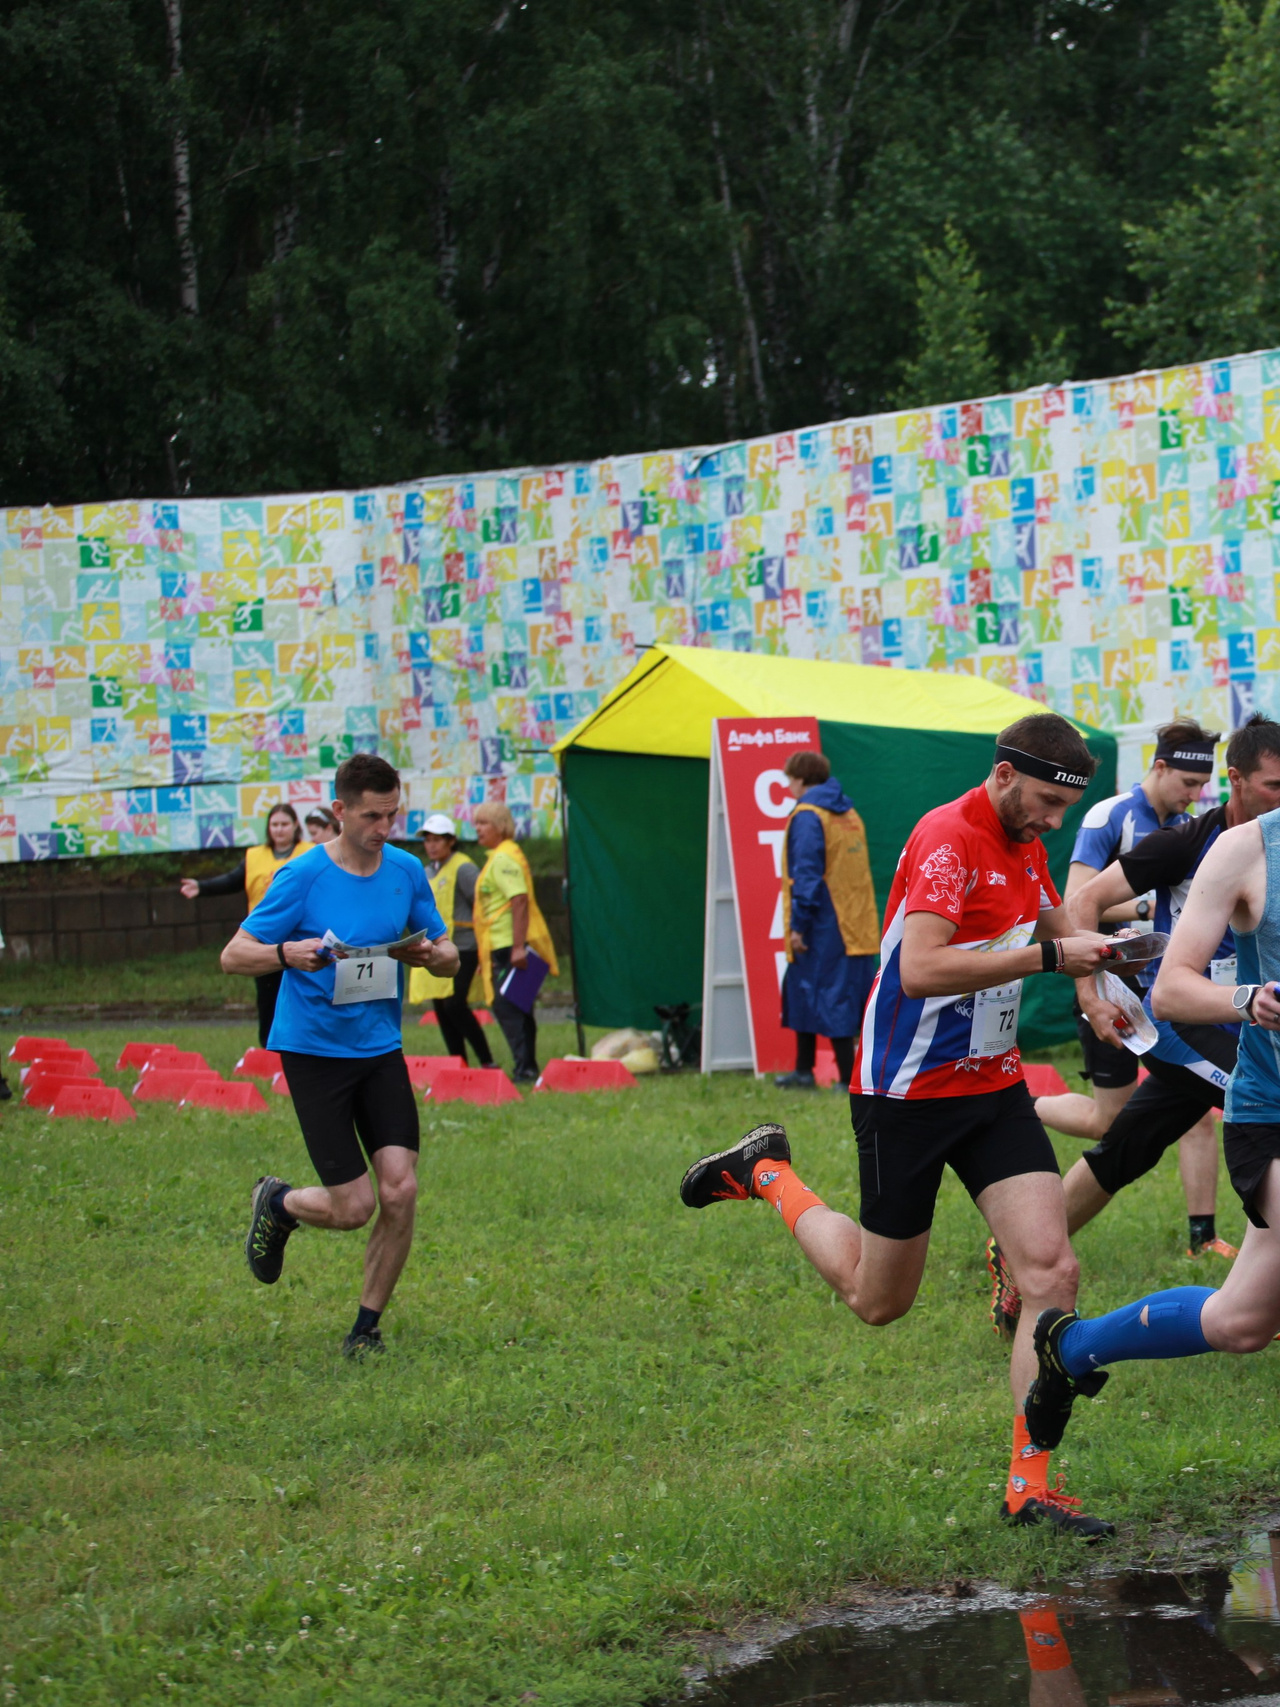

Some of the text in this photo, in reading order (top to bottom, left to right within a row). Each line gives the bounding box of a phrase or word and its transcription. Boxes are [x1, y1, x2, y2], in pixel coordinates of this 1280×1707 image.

[727, 728, 812, 751] Альфа Банк
[356, 961, 374, 980] 71
[999, 1008, 1015, 1033] 72
